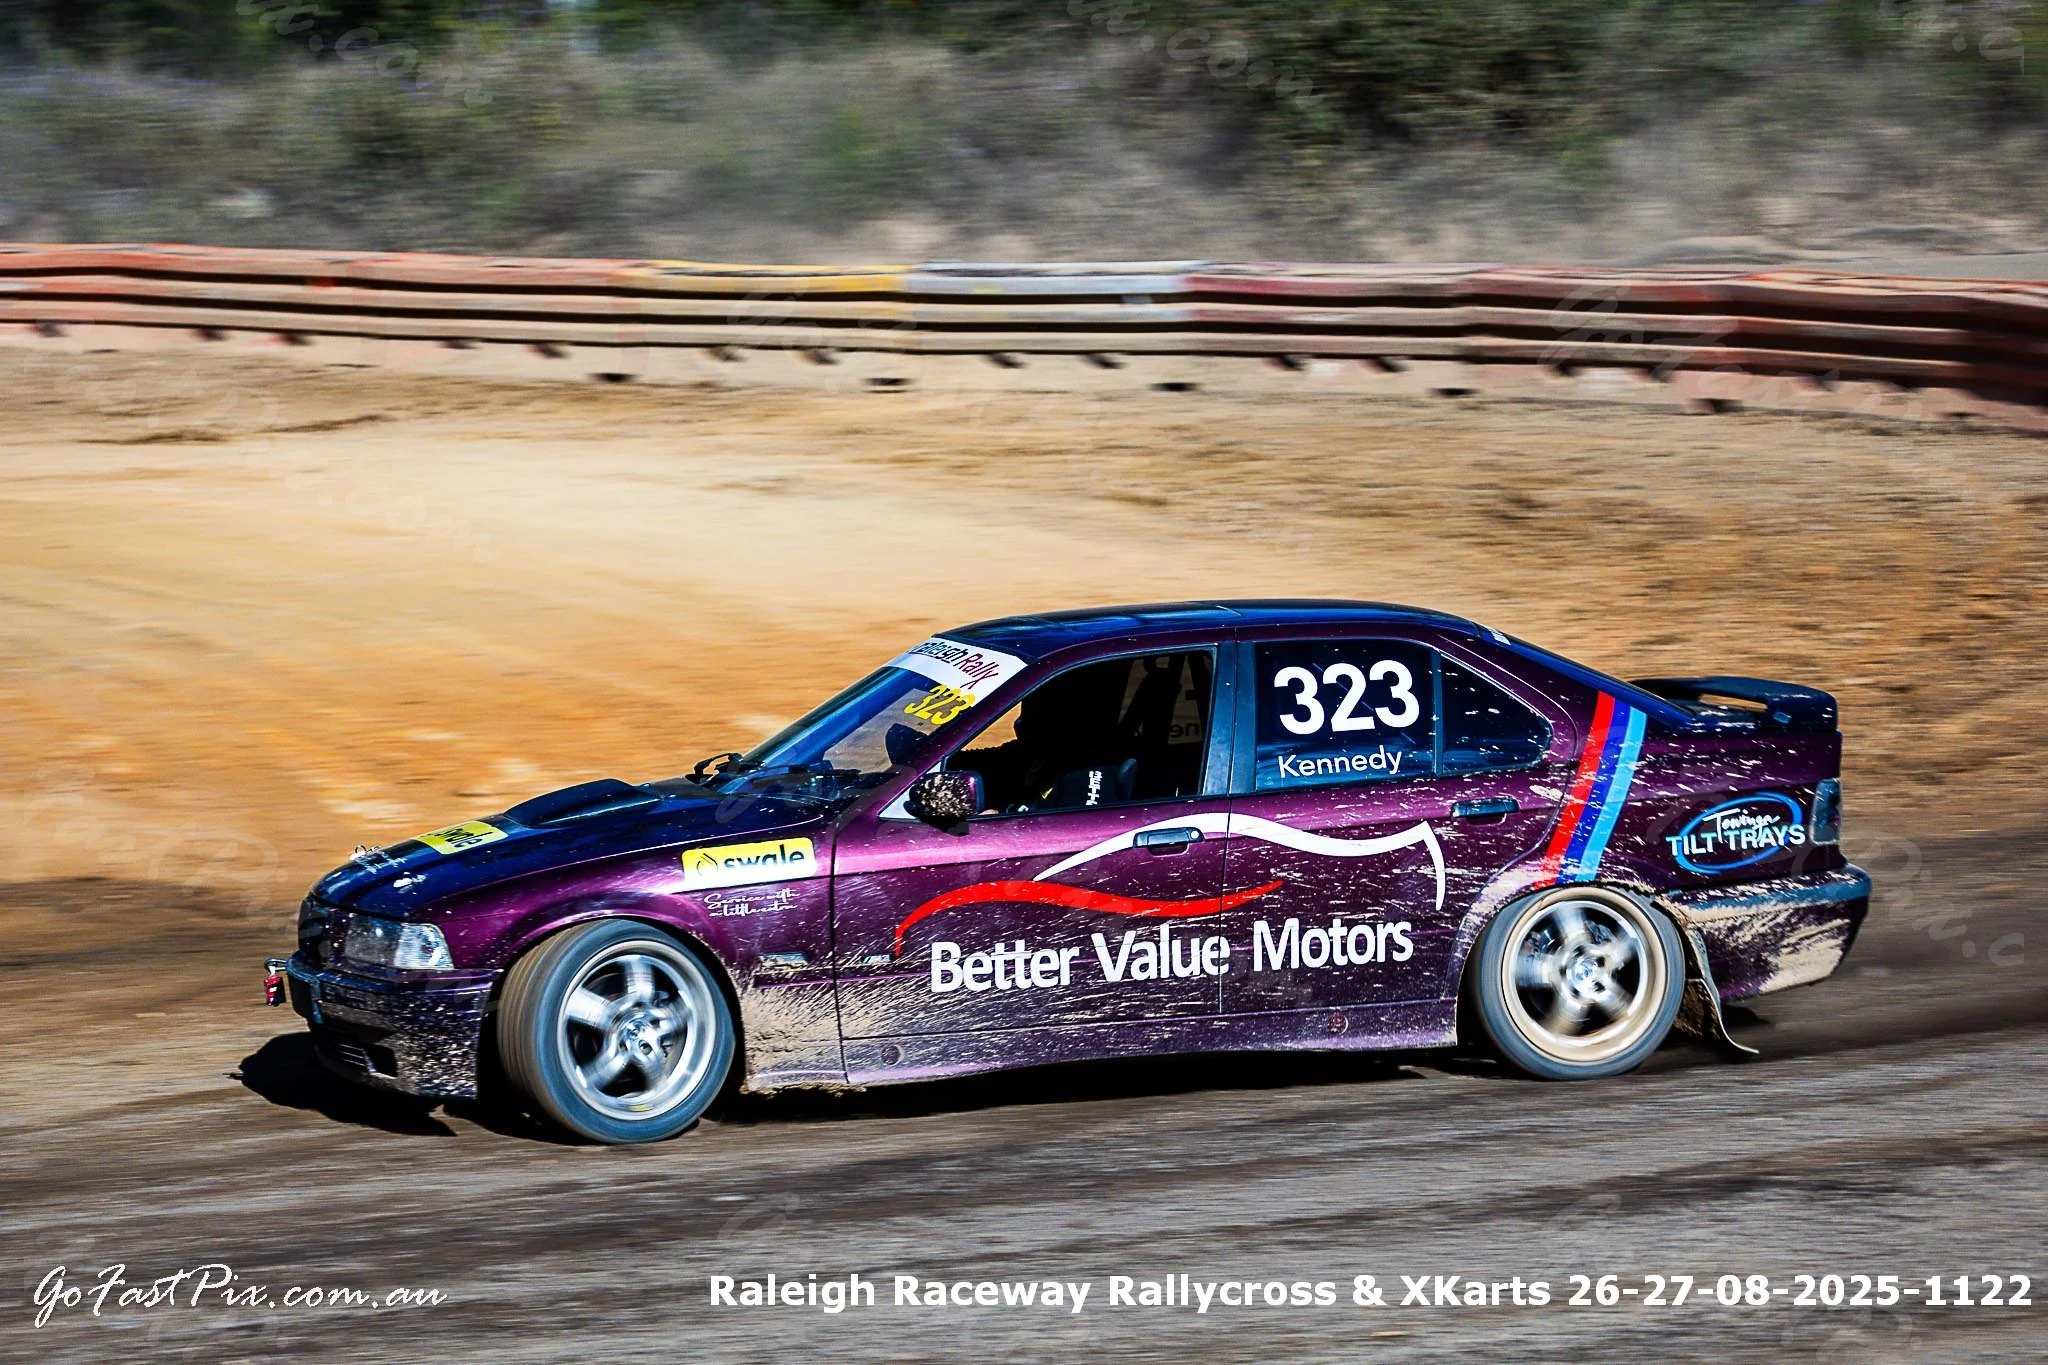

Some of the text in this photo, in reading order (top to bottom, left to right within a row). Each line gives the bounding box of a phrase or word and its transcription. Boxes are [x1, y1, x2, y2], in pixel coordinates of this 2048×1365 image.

[904, 684, 977, 725] 323
[1274, 660, 1420, 735] 323
[1278, 744, 1402, 779] Kennedy
[724, 843, 805, 869] swale
[1666, 824, 1806, 857] TILT TRAYS
[931, 918, 1414, 993] Better Value Motors
